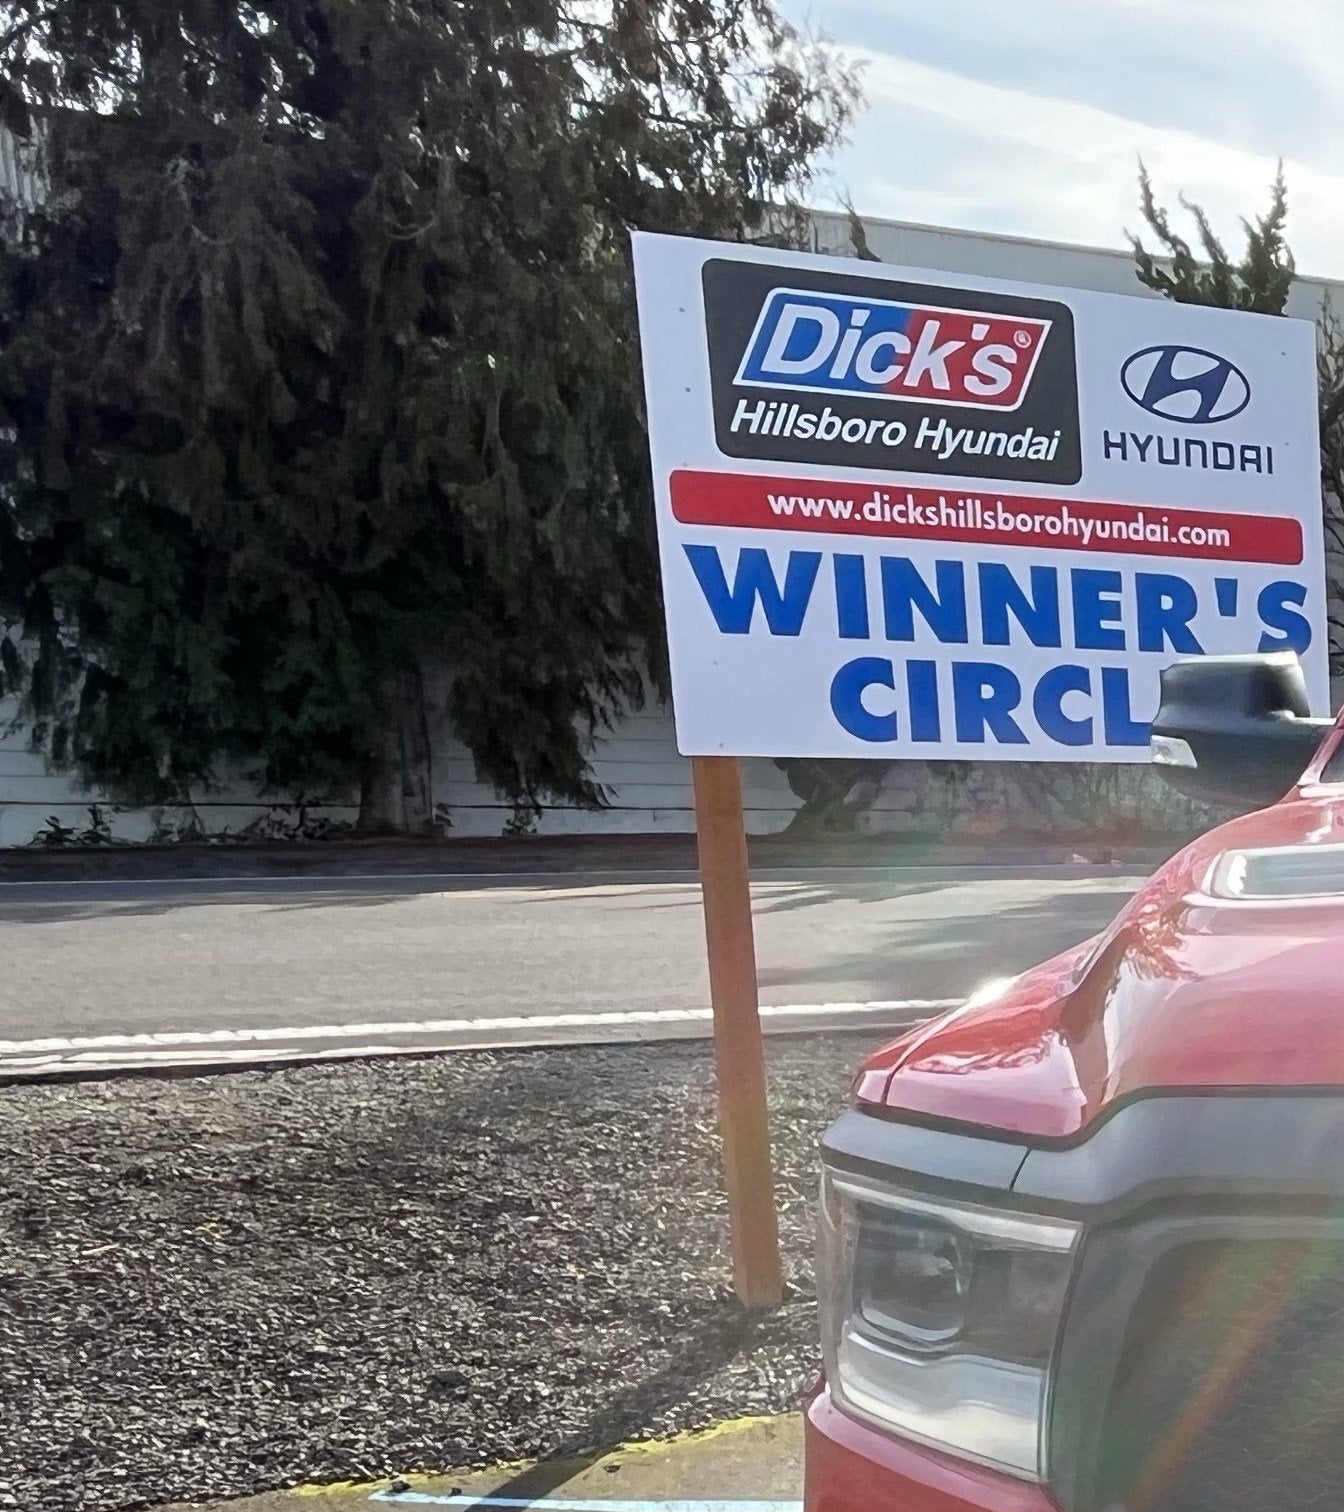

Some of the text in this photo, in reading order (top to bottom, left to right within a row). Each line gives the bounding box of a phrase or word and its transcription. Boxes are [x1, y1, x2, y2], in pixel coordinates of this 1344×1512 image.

[760, 303, 1018, 396] Dick's
[730, 399, 1061, 460] Hillsboro Hyundai
[1103, 430, 1273, 474] HYUNDAI
[767, 492, 1231, 548] www.dickshillsborohyundai.com
[682, 544, 1312, 655] WINNER'S
[830, 656, 1156, 747] CIRCL
